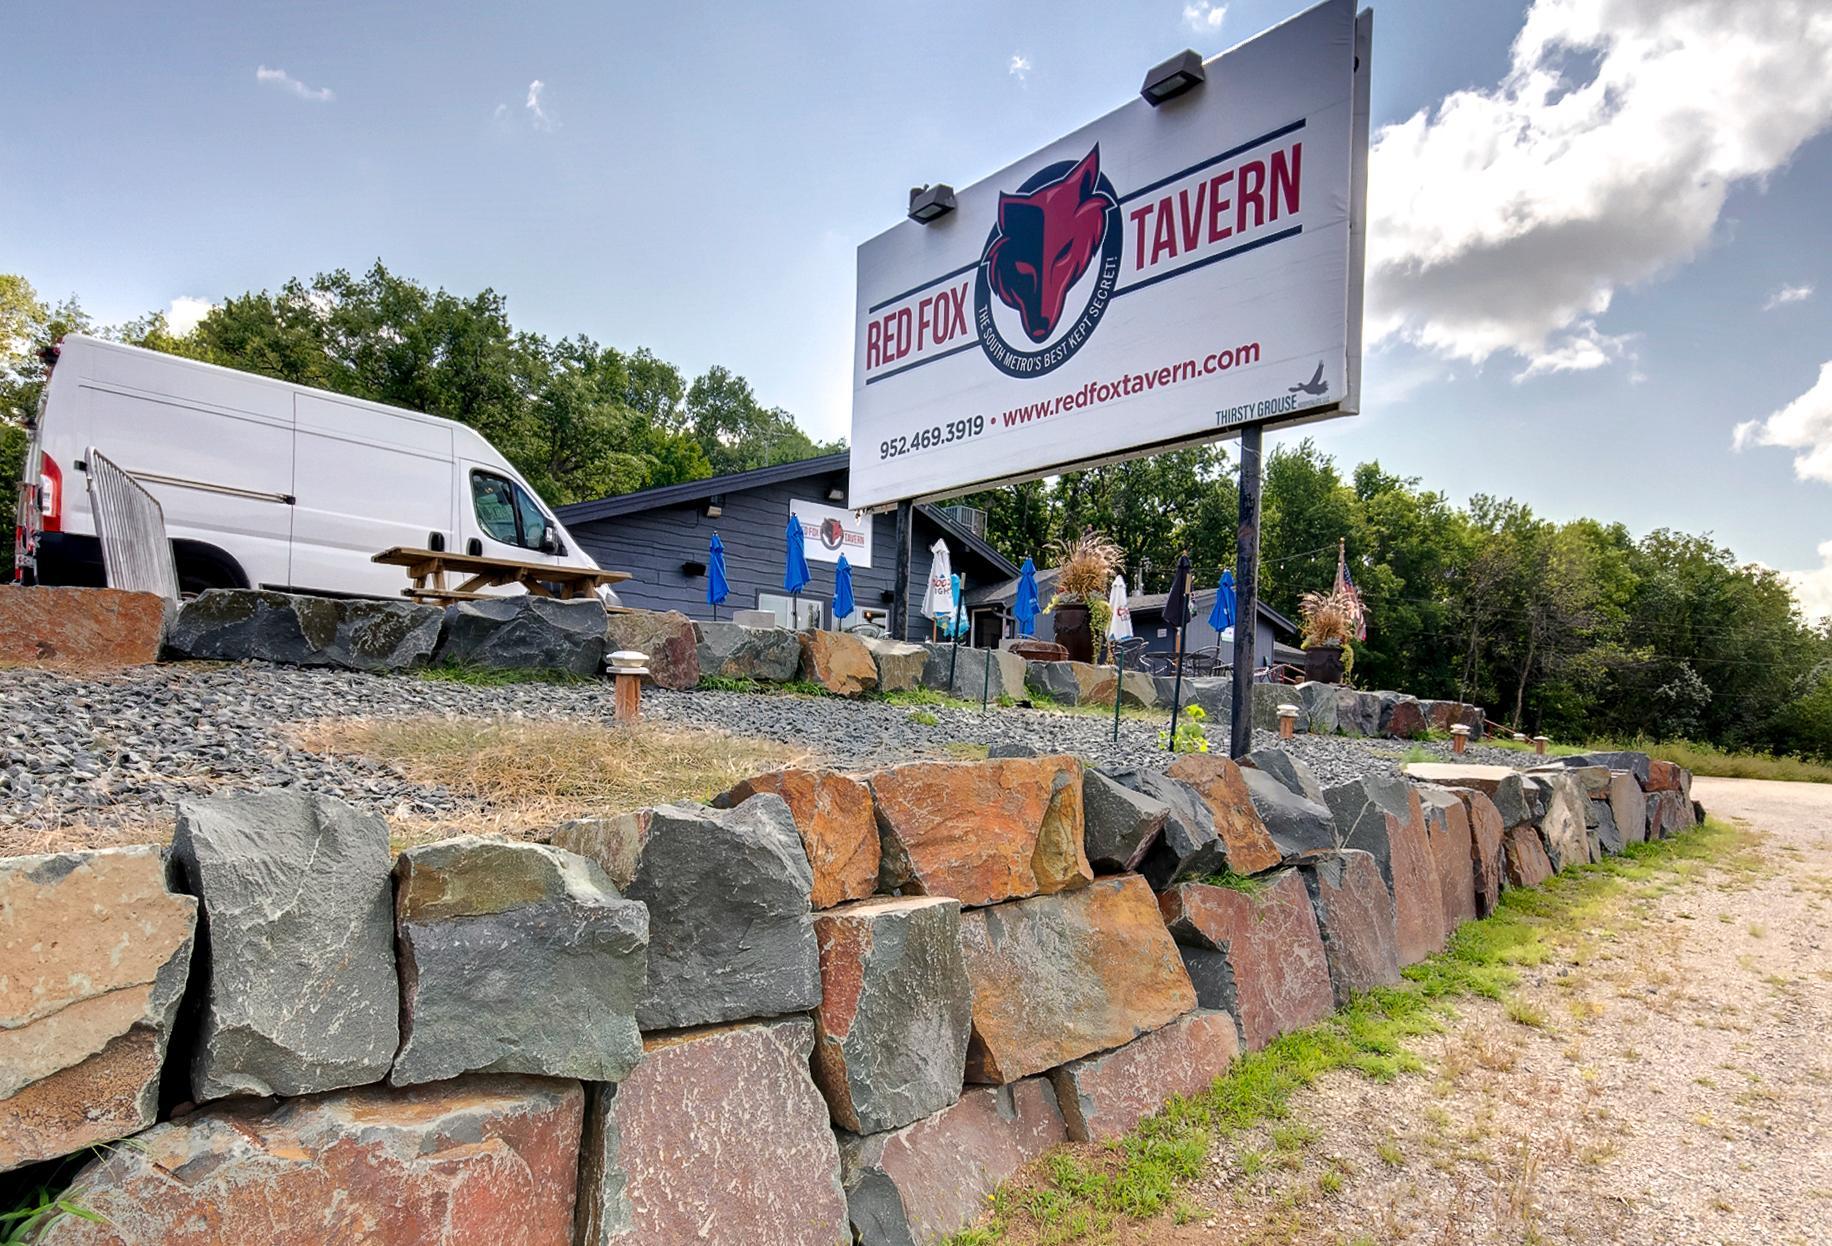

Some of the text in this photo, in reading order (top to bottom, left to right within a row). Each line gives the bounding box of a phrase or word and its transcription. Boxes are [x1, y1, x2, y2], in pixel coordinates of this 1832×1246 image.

[866, 142, 1302, 371] RED FOX TAVERN
[979, 256, 1118, 372] THE SOUTH METRO'S BEST KEPT SECRET!
[880, 341, 1262, 460] 952.469.3919 www.redfoxtavern.com
[1216, 403, 1256, 426] THIRSTY
[1257, 394, 1298, 417] GROUSE
